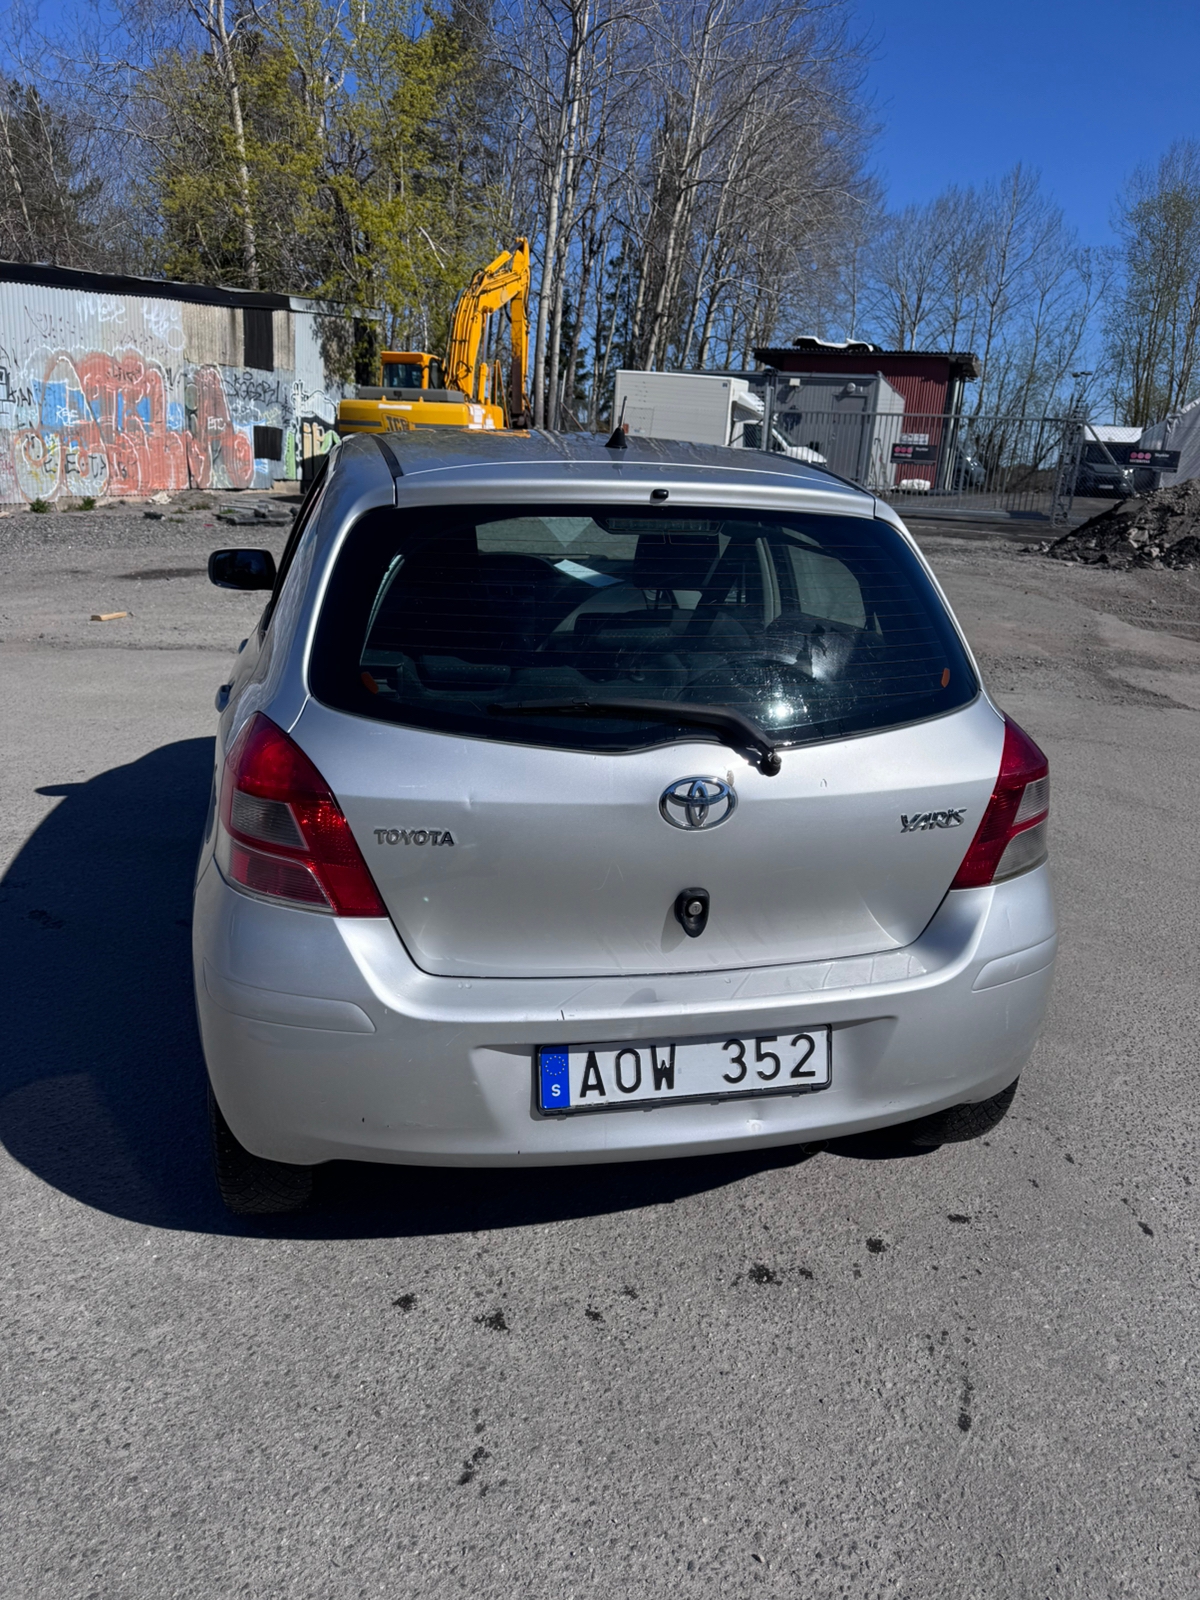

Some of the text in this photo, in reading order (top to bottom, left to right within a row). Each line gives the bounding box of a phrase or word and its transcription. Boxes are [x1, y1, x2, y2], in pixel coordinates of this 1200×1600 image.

[900, 808, 967, 833] YARIS
[373, 828, 455, 847] TOYOTA
[579, 1033, 816, 1098] AOW 352
[551, 1083, 562, 1097] S
